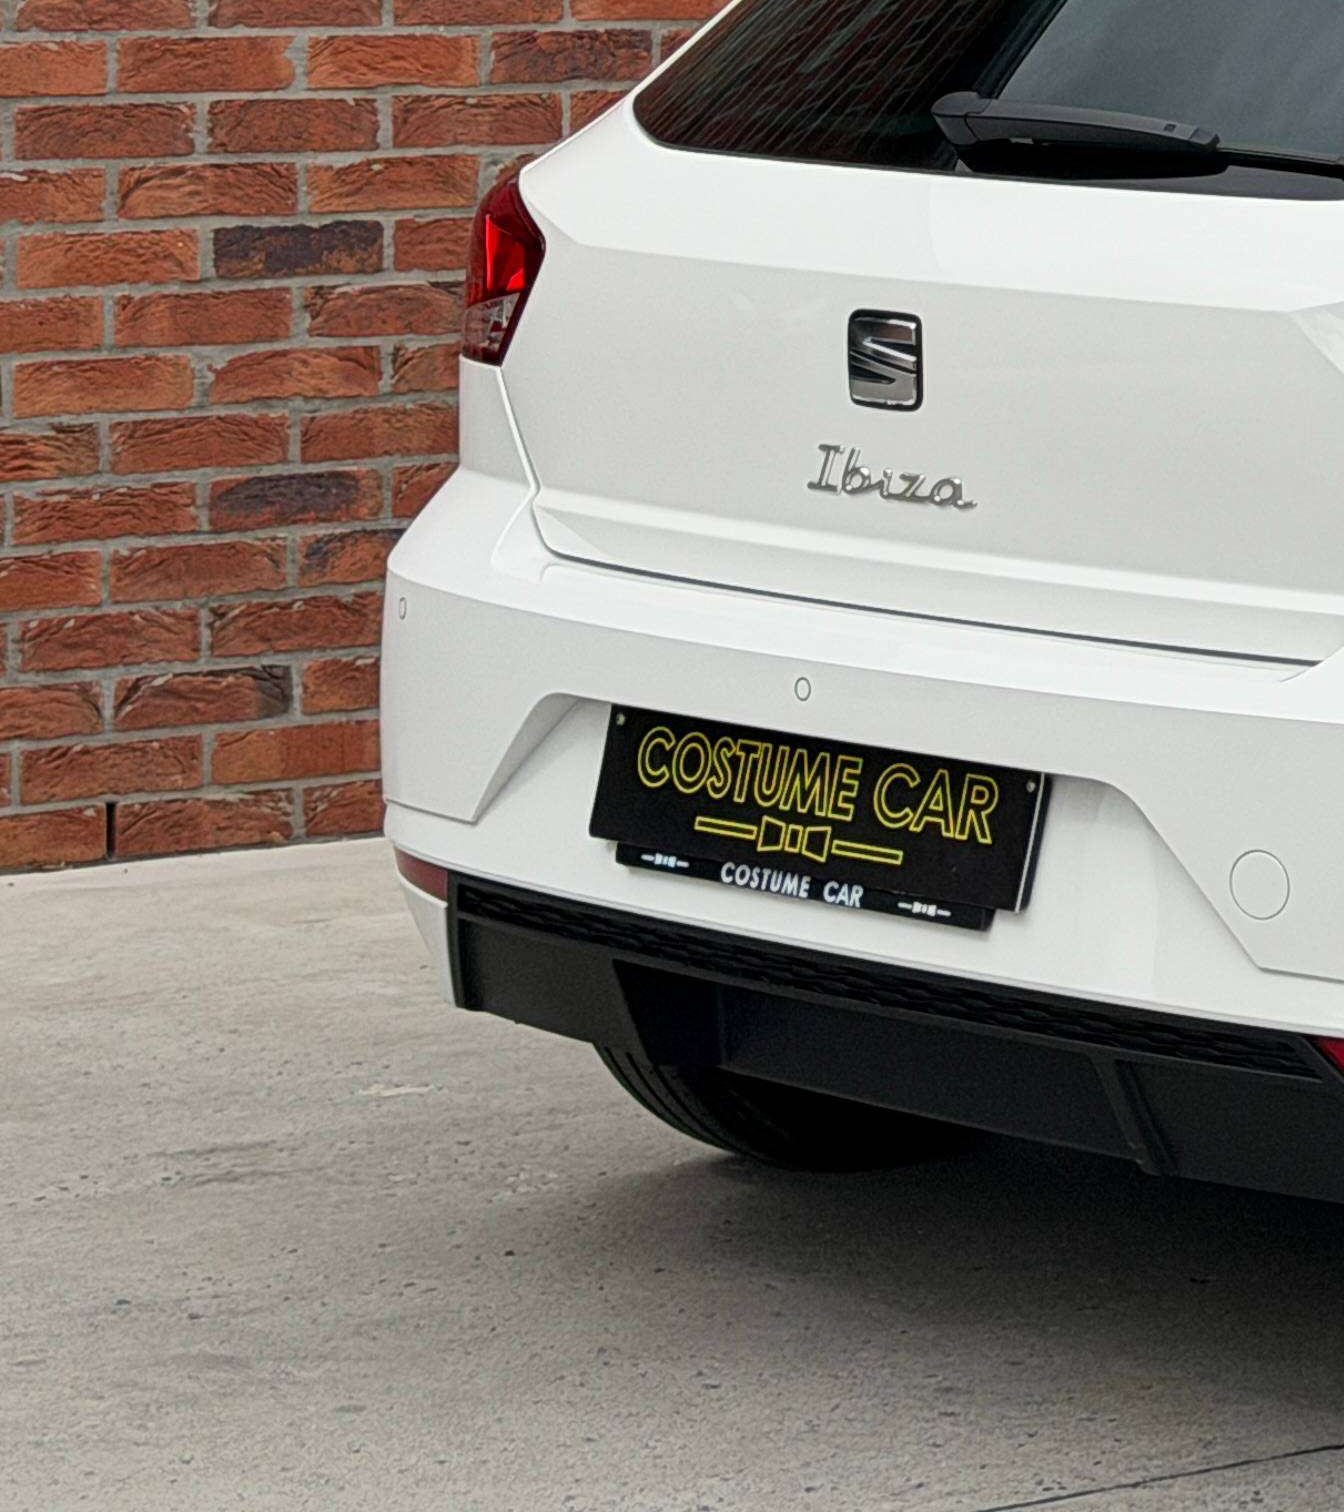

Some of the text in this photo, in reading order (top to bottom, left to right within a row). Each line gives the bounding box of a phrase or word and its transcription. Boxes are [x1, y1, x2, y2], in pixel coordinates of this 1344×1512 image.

[807, 443, 978, 510] Ibiza
[637, 726, 999, 845] COSTUME CAR
[720, 861, 865, 909] COSTUME CAR
